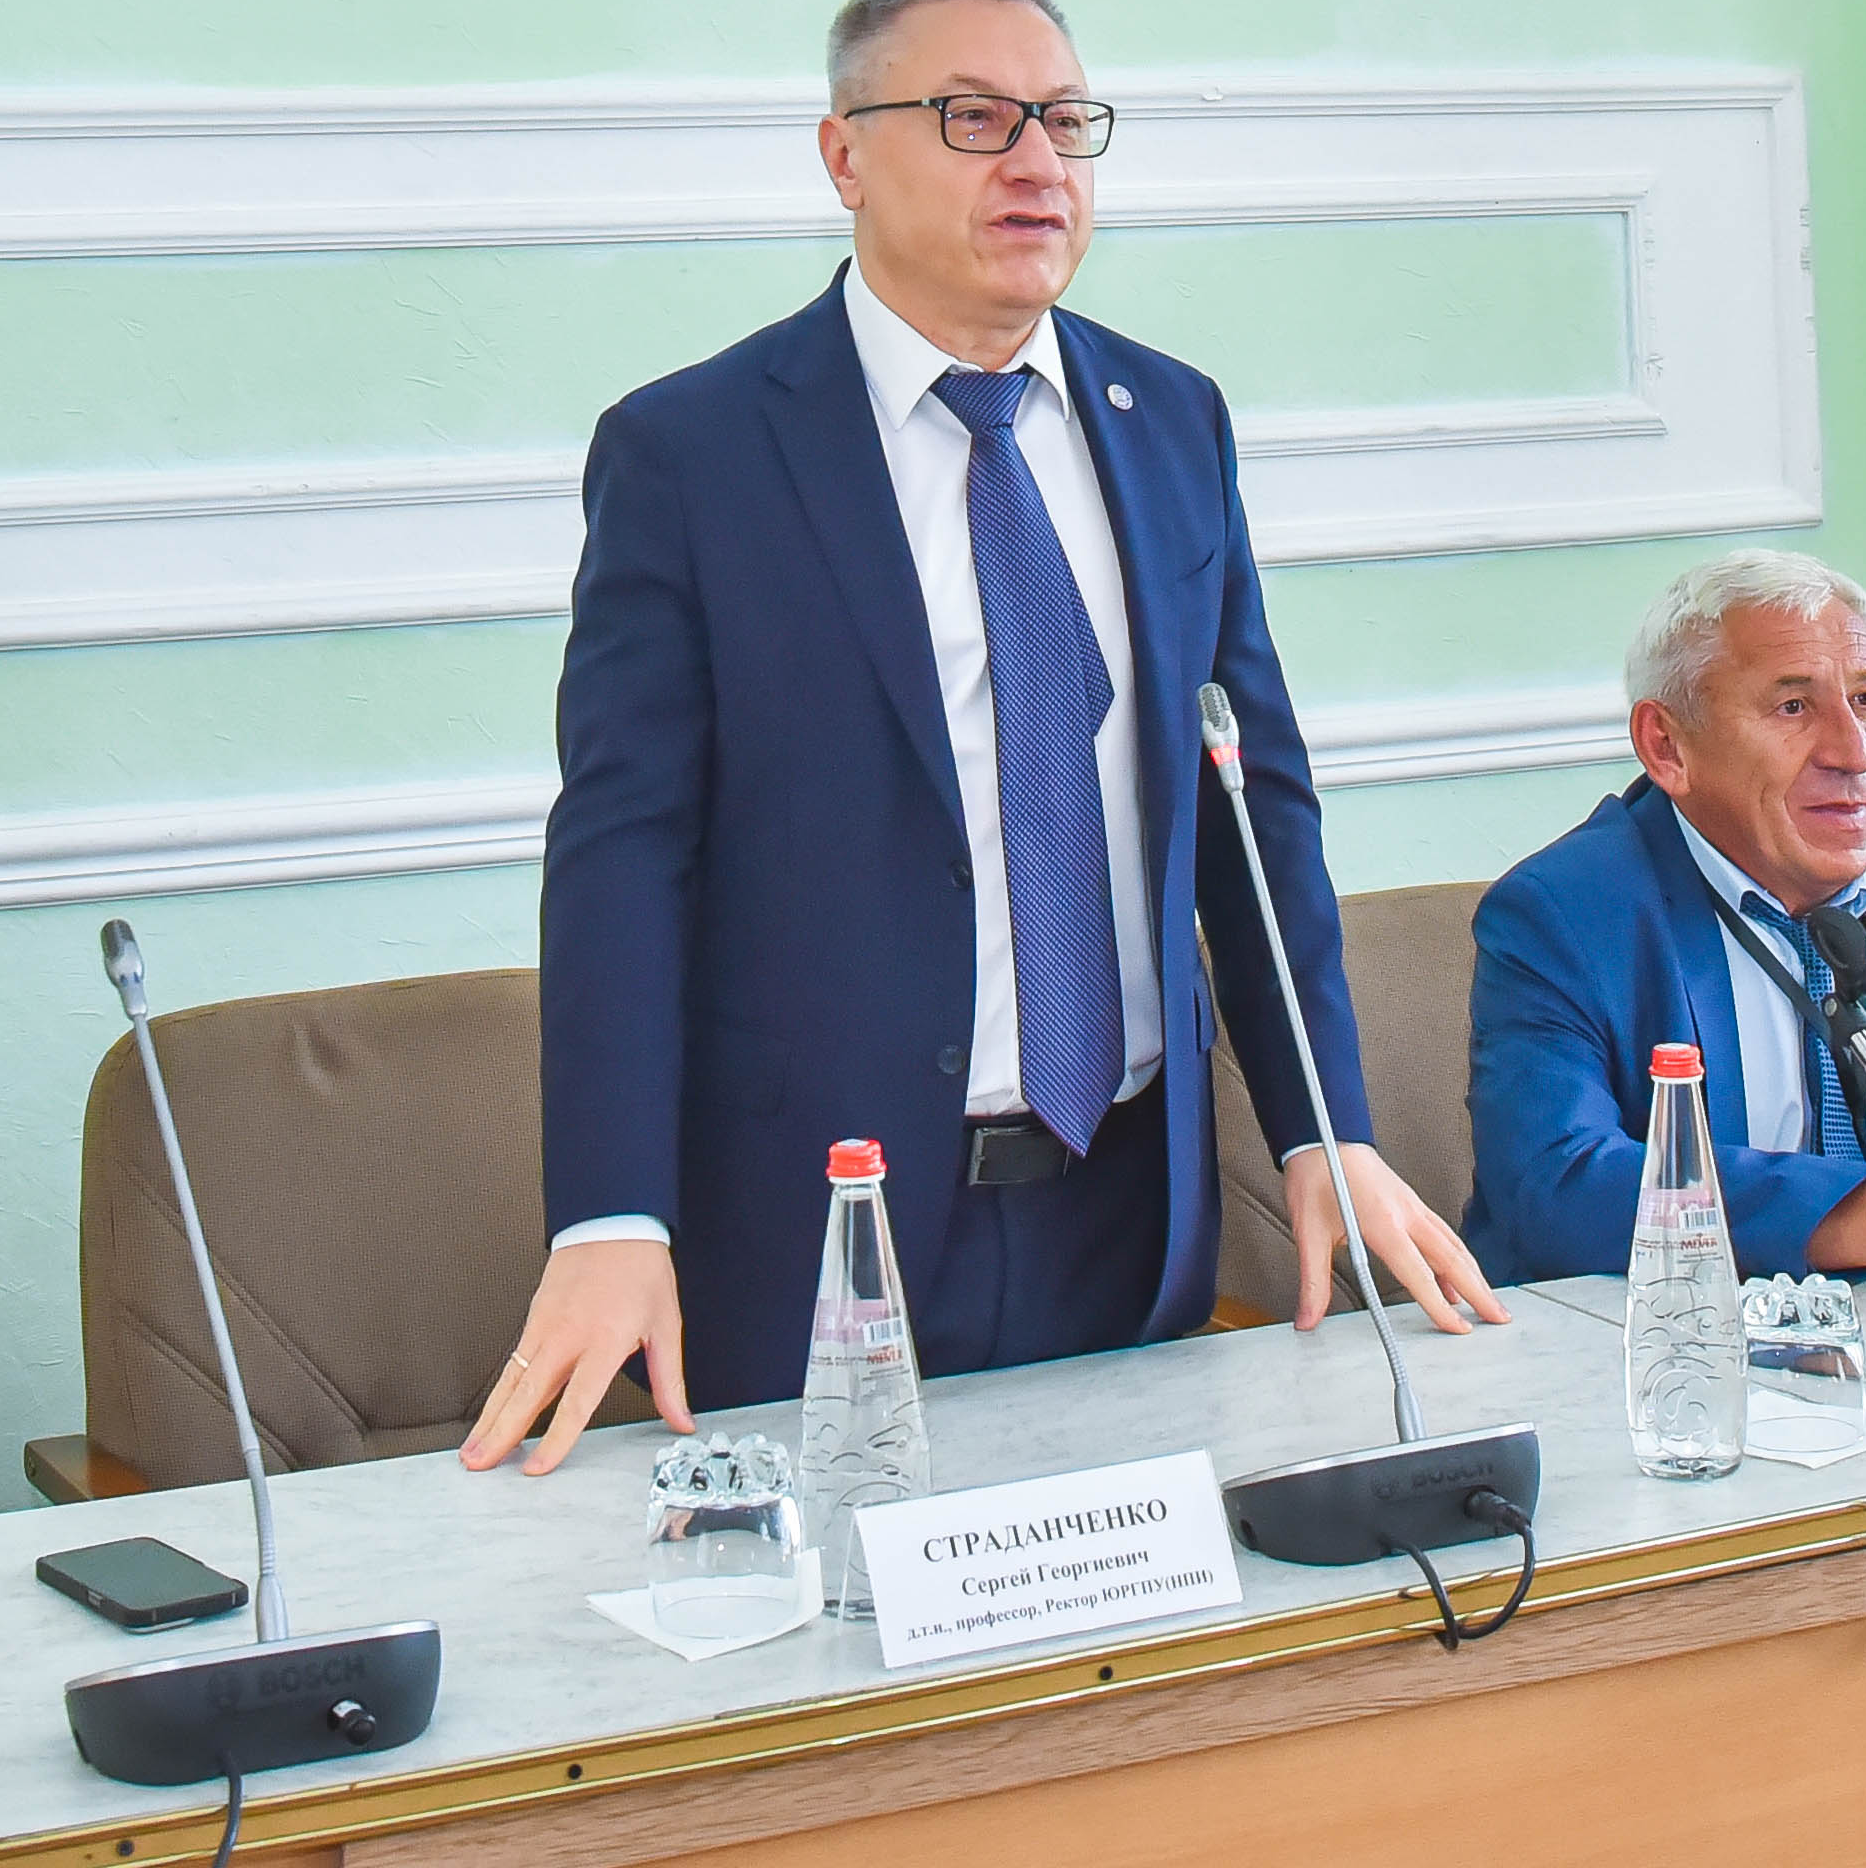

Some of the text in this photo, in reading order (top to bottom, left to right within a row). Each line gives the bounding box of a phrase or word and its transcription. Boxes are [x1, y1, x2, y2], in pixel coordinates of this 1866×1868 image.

[923, 1498, 1168, 1564] СТРАДАНЧЕНКО
[956, 1603, 1042, 1634] профессор,
[1045, 1592, 1098, 1614] Ректор
[1102, 1569, 1215, 1605] ЮРГПУ(НПИ)
[962, 1550, 1150, 1597] Сергей Георгиевич
